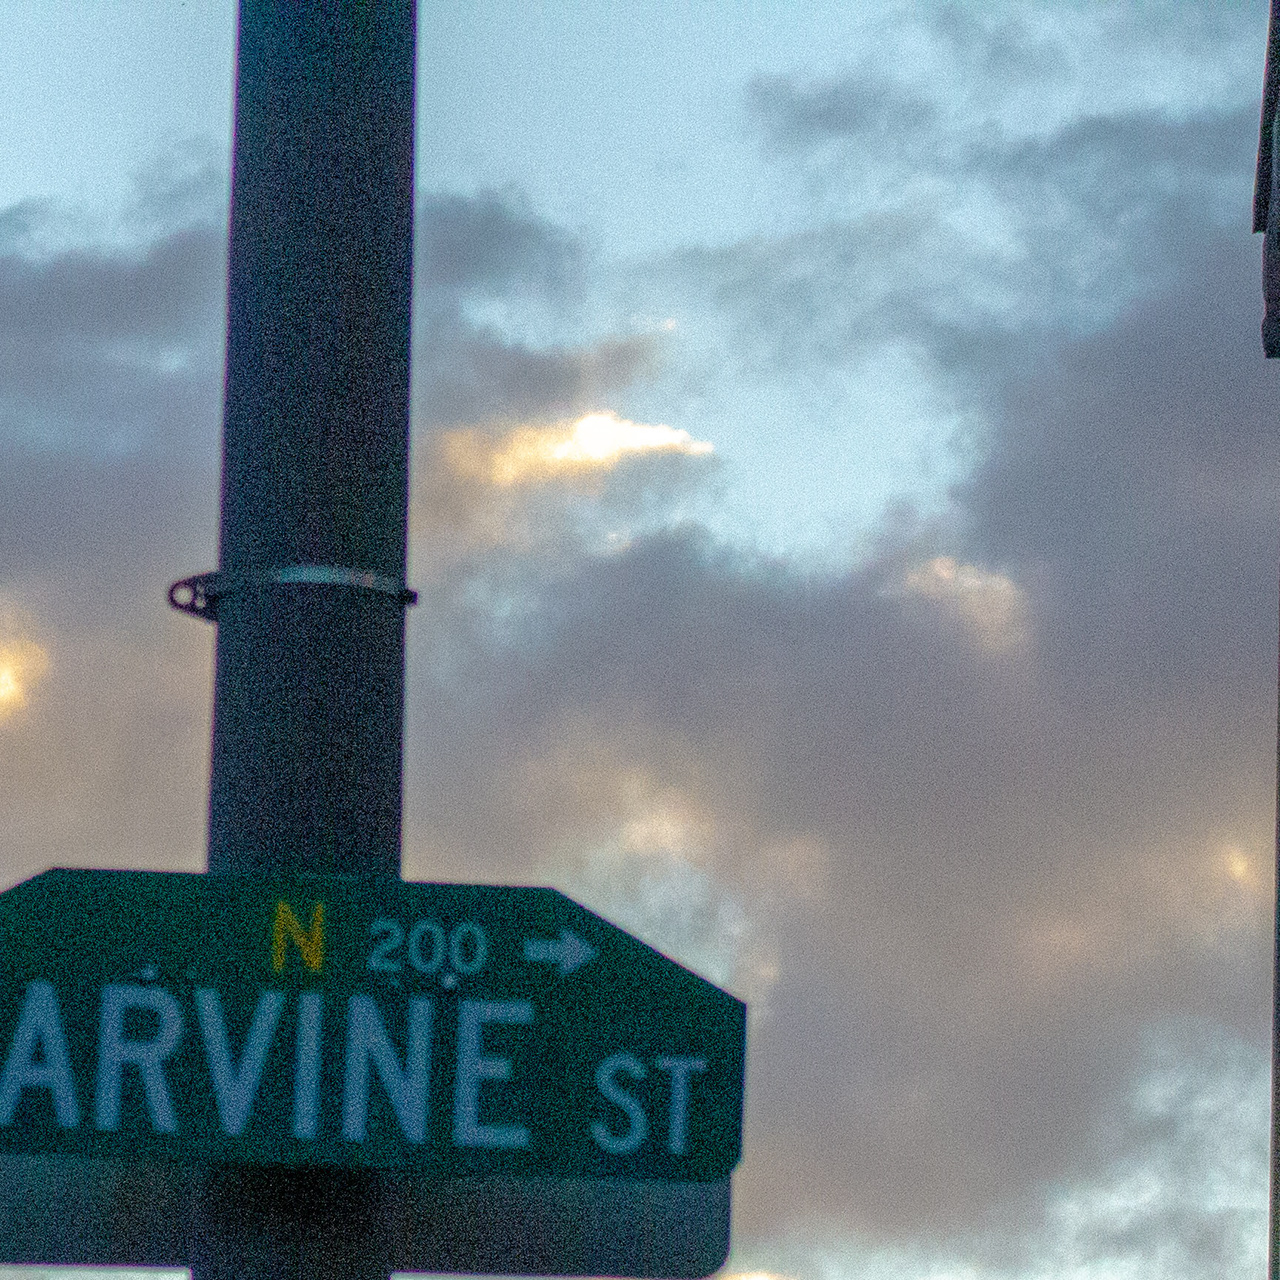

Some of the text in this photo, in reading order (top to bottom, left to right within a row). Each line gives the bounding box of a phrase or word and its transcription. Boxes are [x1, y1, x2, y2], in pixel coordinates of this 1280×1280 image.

[271, 901, 488, 978] N 200
[590, 1054, 709, 1156] ST
